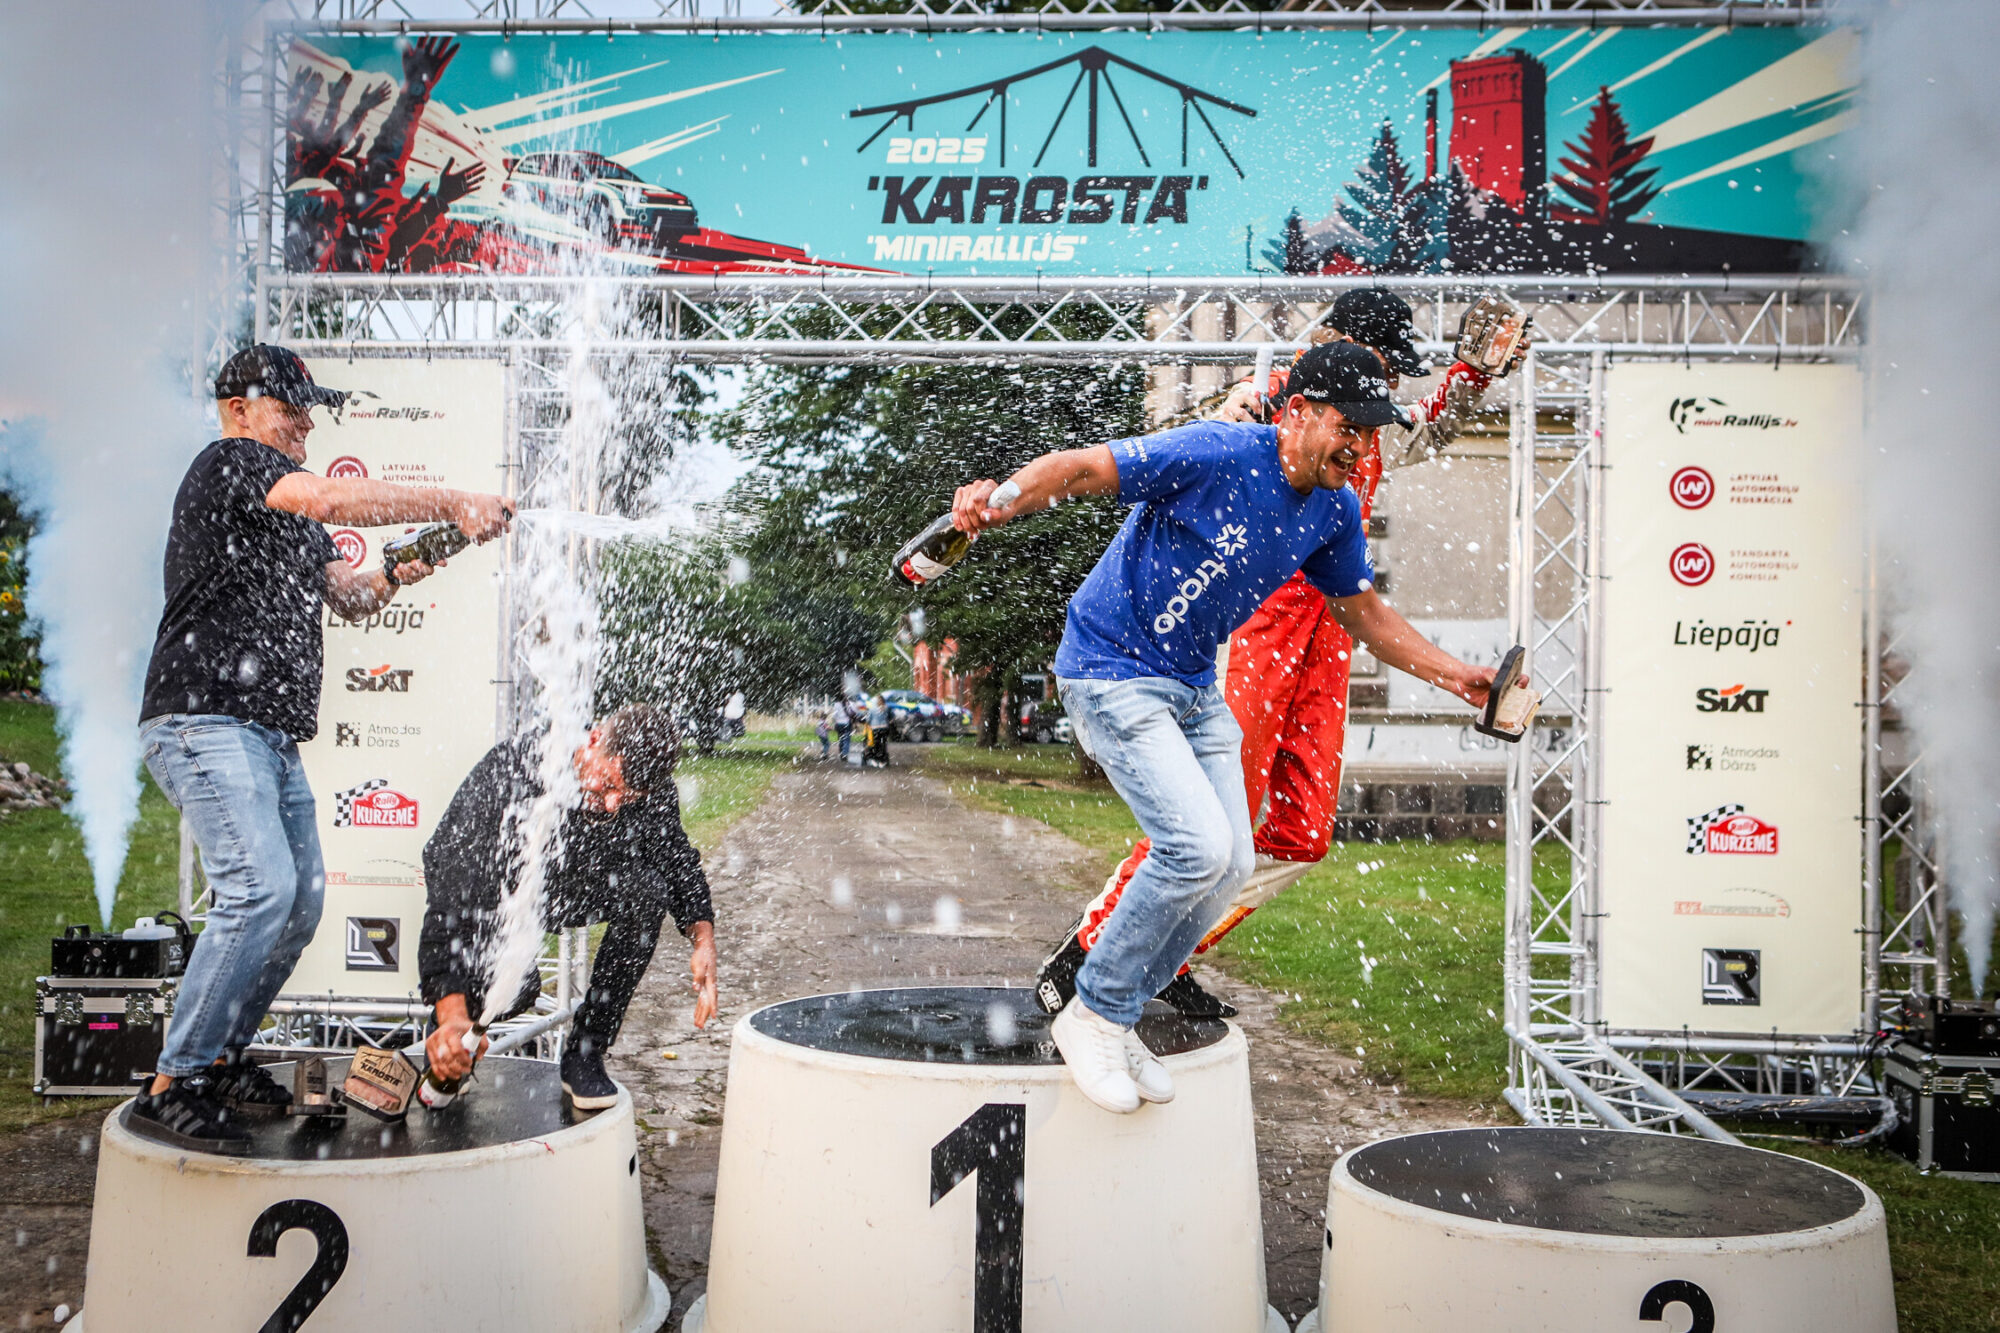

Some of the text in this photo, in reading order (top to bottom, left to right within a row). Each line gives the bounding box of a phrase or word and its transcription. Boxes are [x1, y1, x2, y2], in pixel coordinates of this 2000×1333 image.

[886, 137, 988, 164] 2025
[1730, 473, 1778, 482] LATVIJAS
[1154, 559, 1228, 634] trodo
[327, 603, 424, 634] Lpāja
[1674, 619, 1780, 652] Liepāja
[368, 723, 422, 735] Atmodas
[1721, 746, 1779, 758] Atmodas
[356, 804, 415, 825] KURZEME
[1709, 831, 1775, 852] KURZEME
[1040, 981, 1061, 1010] OMP
[930, 1102, 1027, 1333] 1
[246, 1198, 350, 1333] 2
